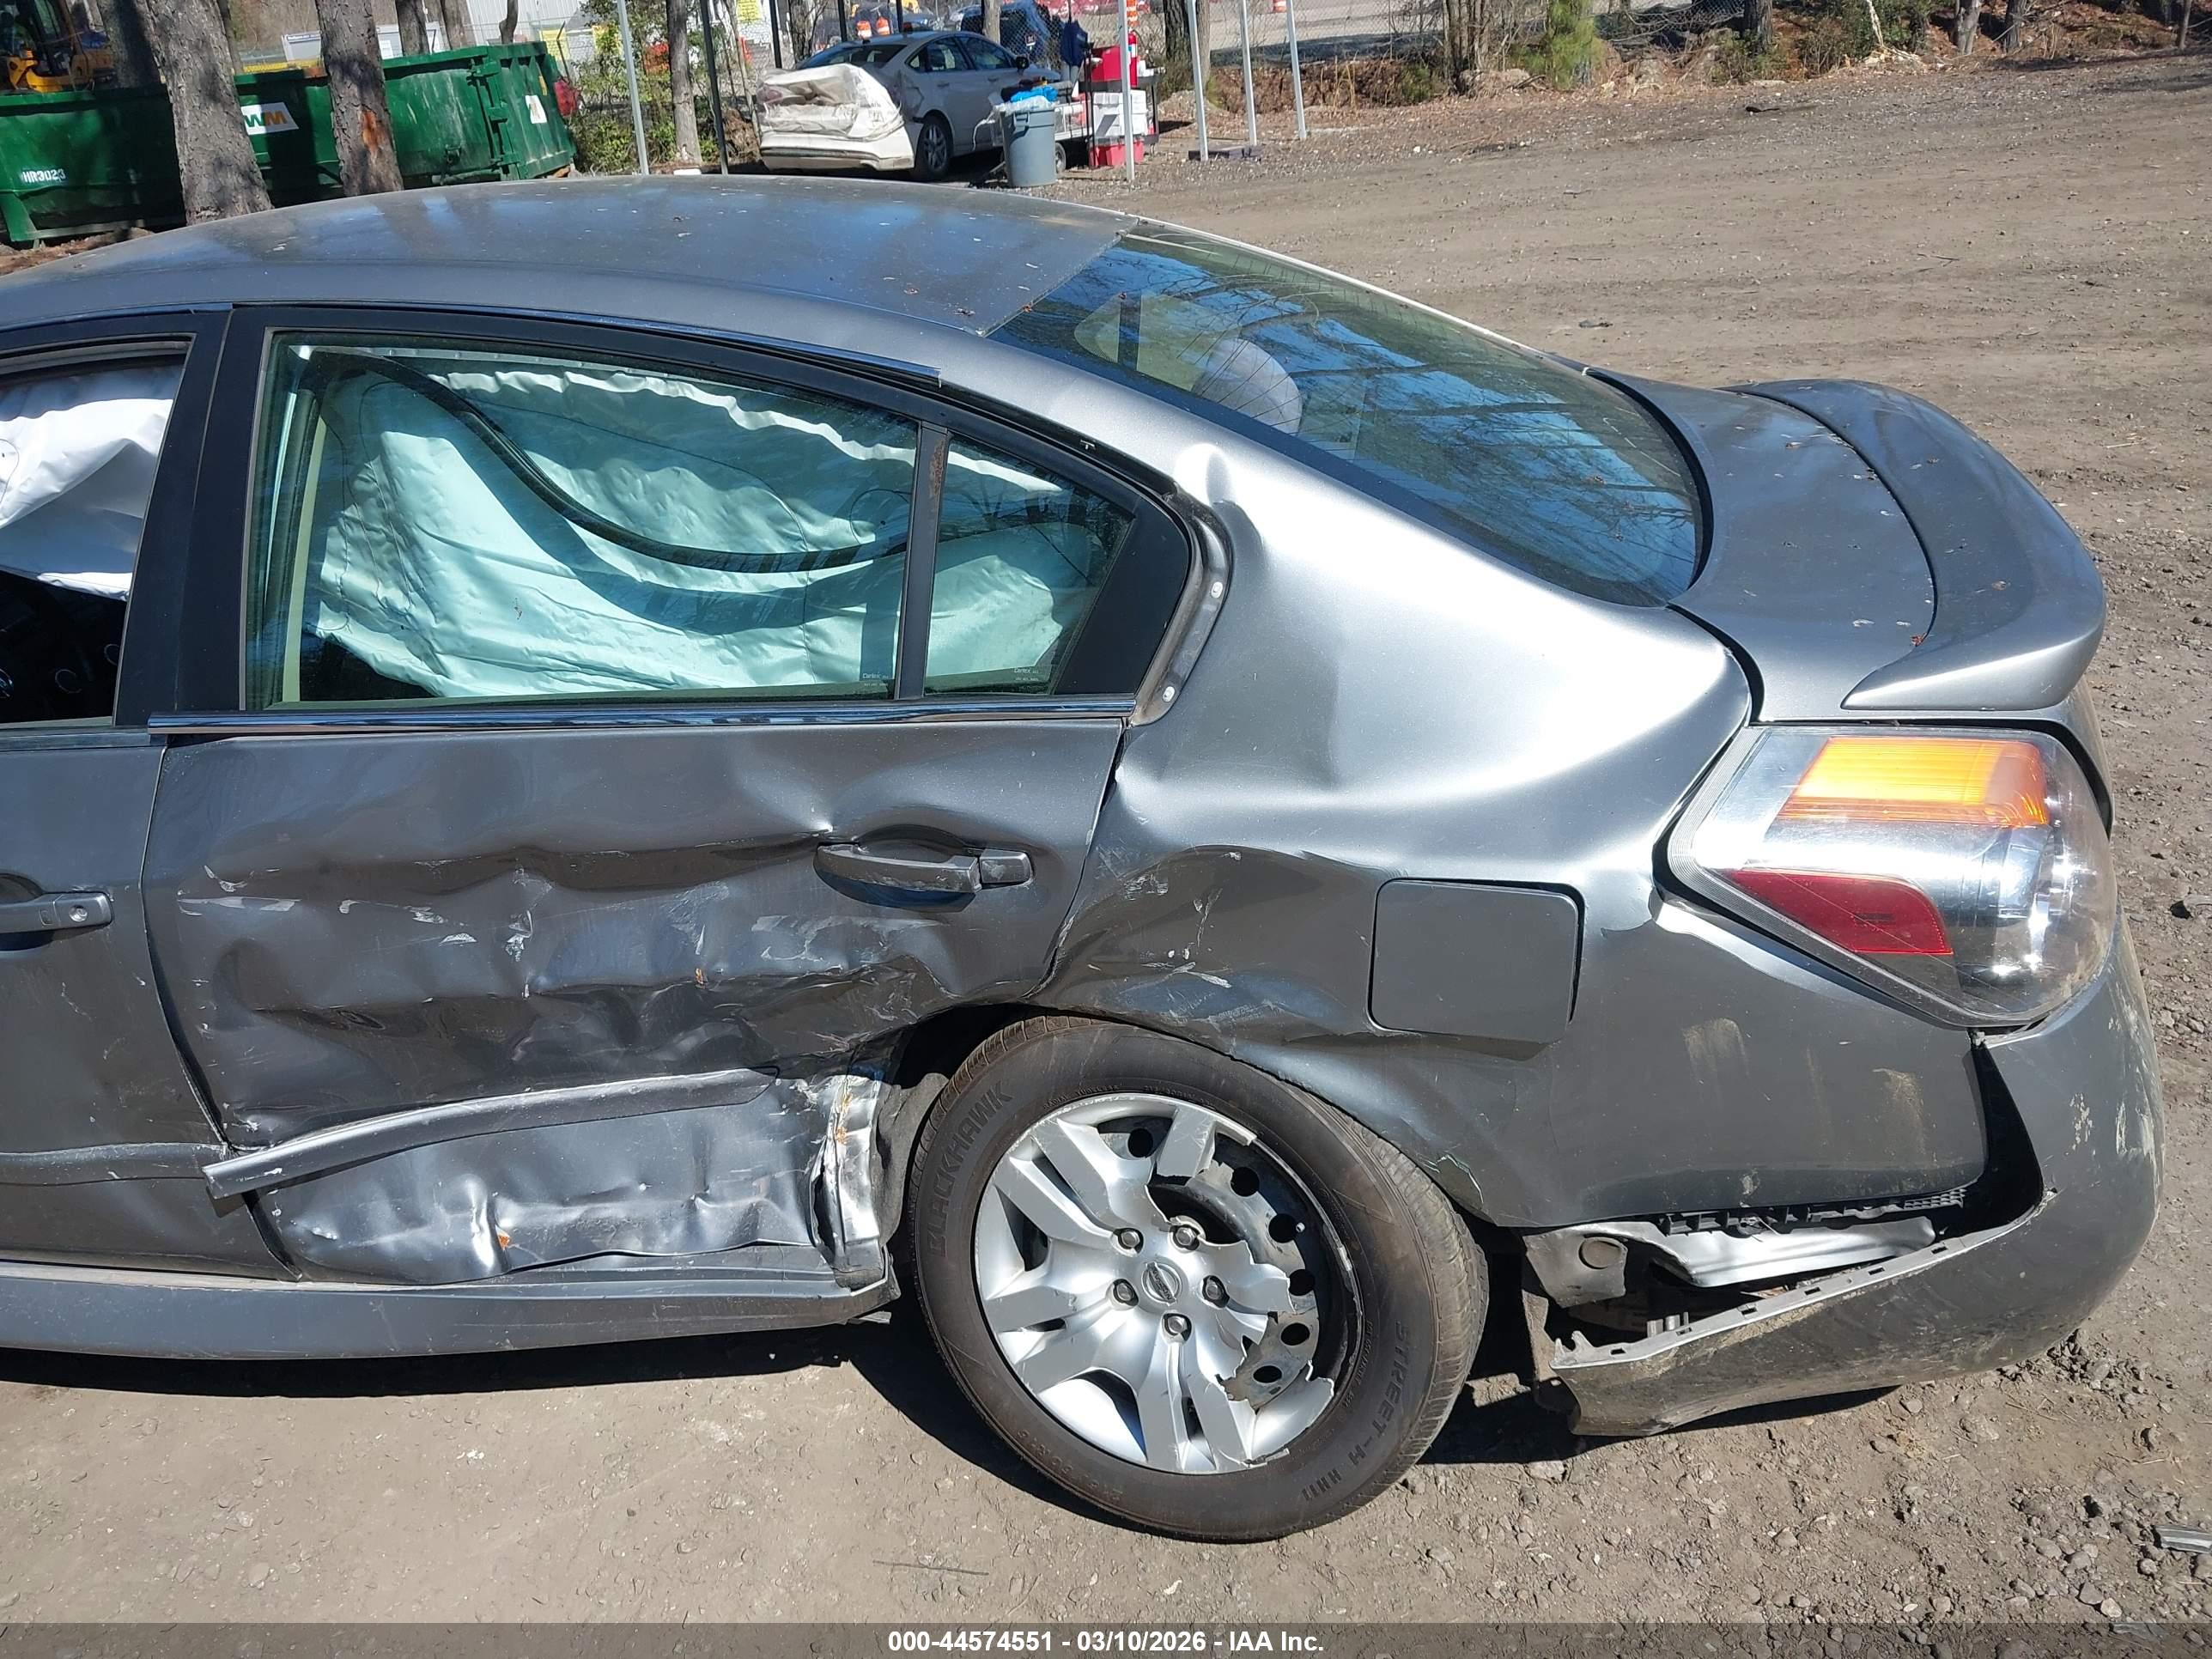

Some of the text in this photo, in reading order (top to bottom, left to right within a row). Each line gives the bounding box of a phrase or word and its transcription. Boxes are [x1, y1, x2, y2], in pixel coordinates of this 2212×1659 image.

[243, 110, 289, 128] WM
[21, 167, 67, 184] HR3023
[927, 1079, 1013, 1258] BLACKHAWK
